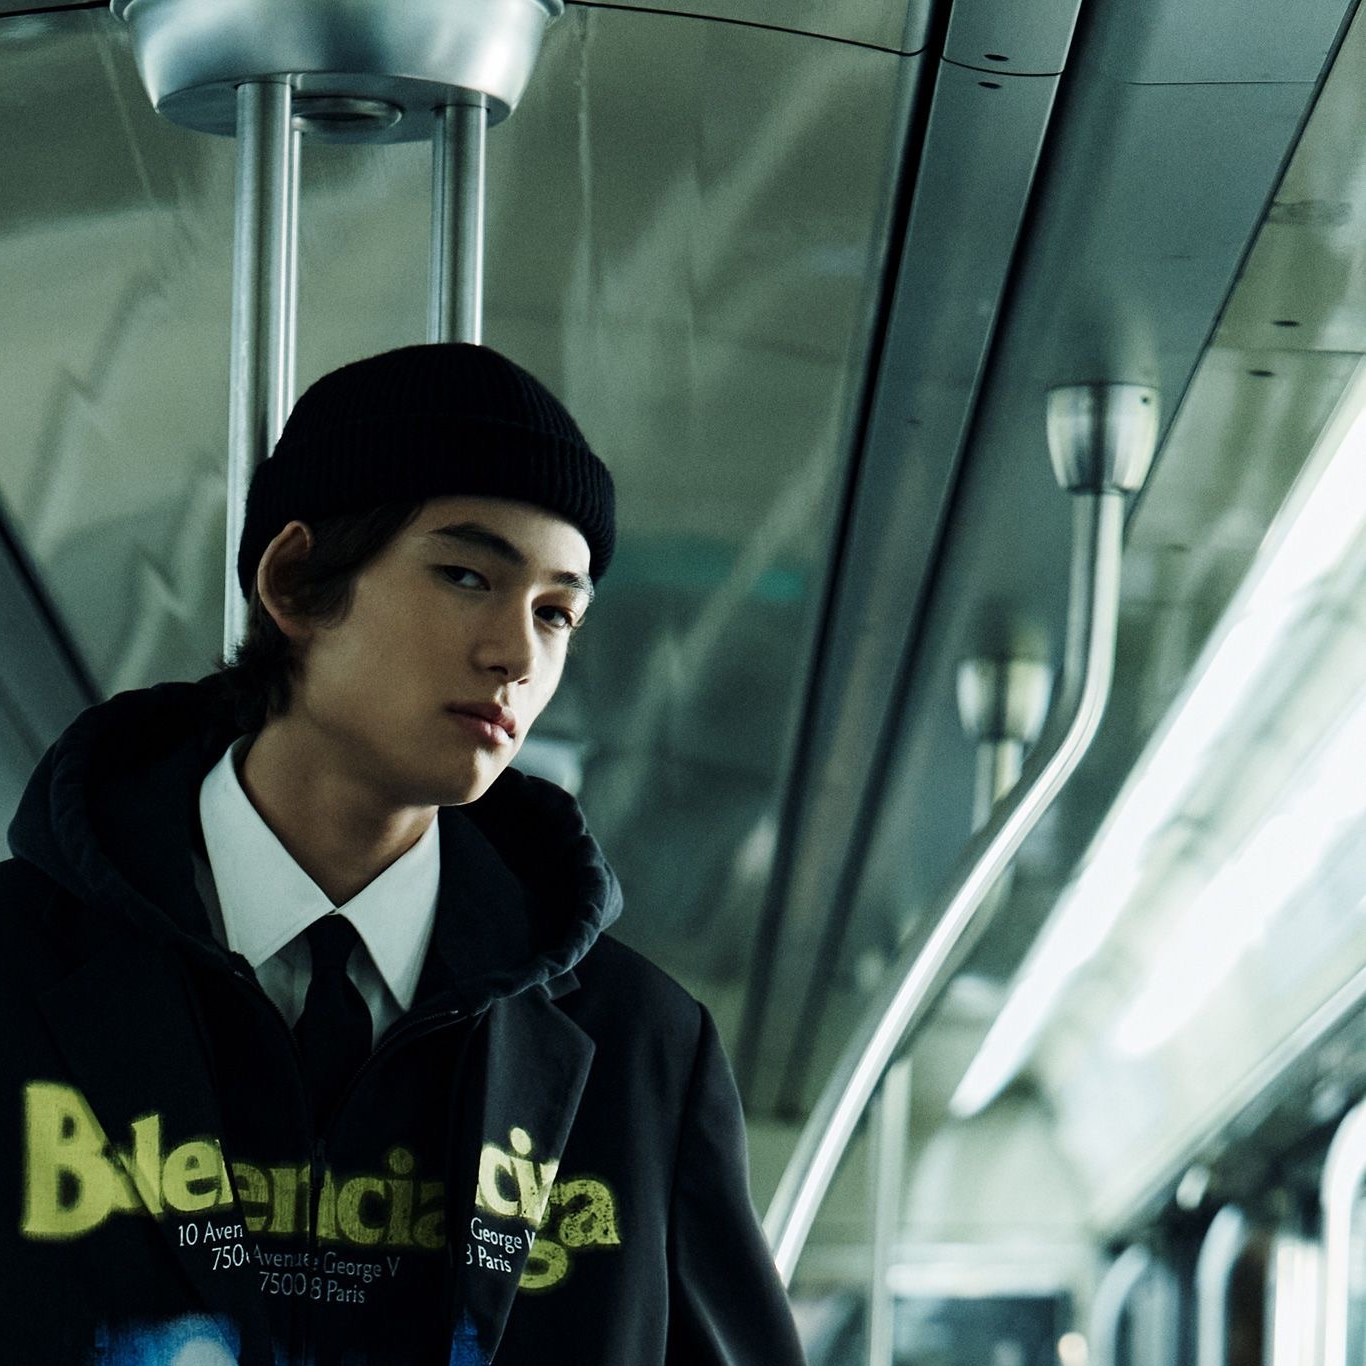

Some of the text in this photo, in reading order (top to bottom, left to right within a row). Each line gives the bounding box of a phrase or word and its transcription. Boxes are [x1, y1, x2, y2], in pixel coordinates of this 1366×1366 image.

[178, 1223, 199, 1247] 10
[470, 1216, 523, 1254] George
[211, 1243, 251, 1271] 750
[323, 1251, 382, 1284] George
[386, 1255, 401, 1277] V
[477, 1245, 513, 1273] Paris
[326, 1279, 366, 1304] Paris
